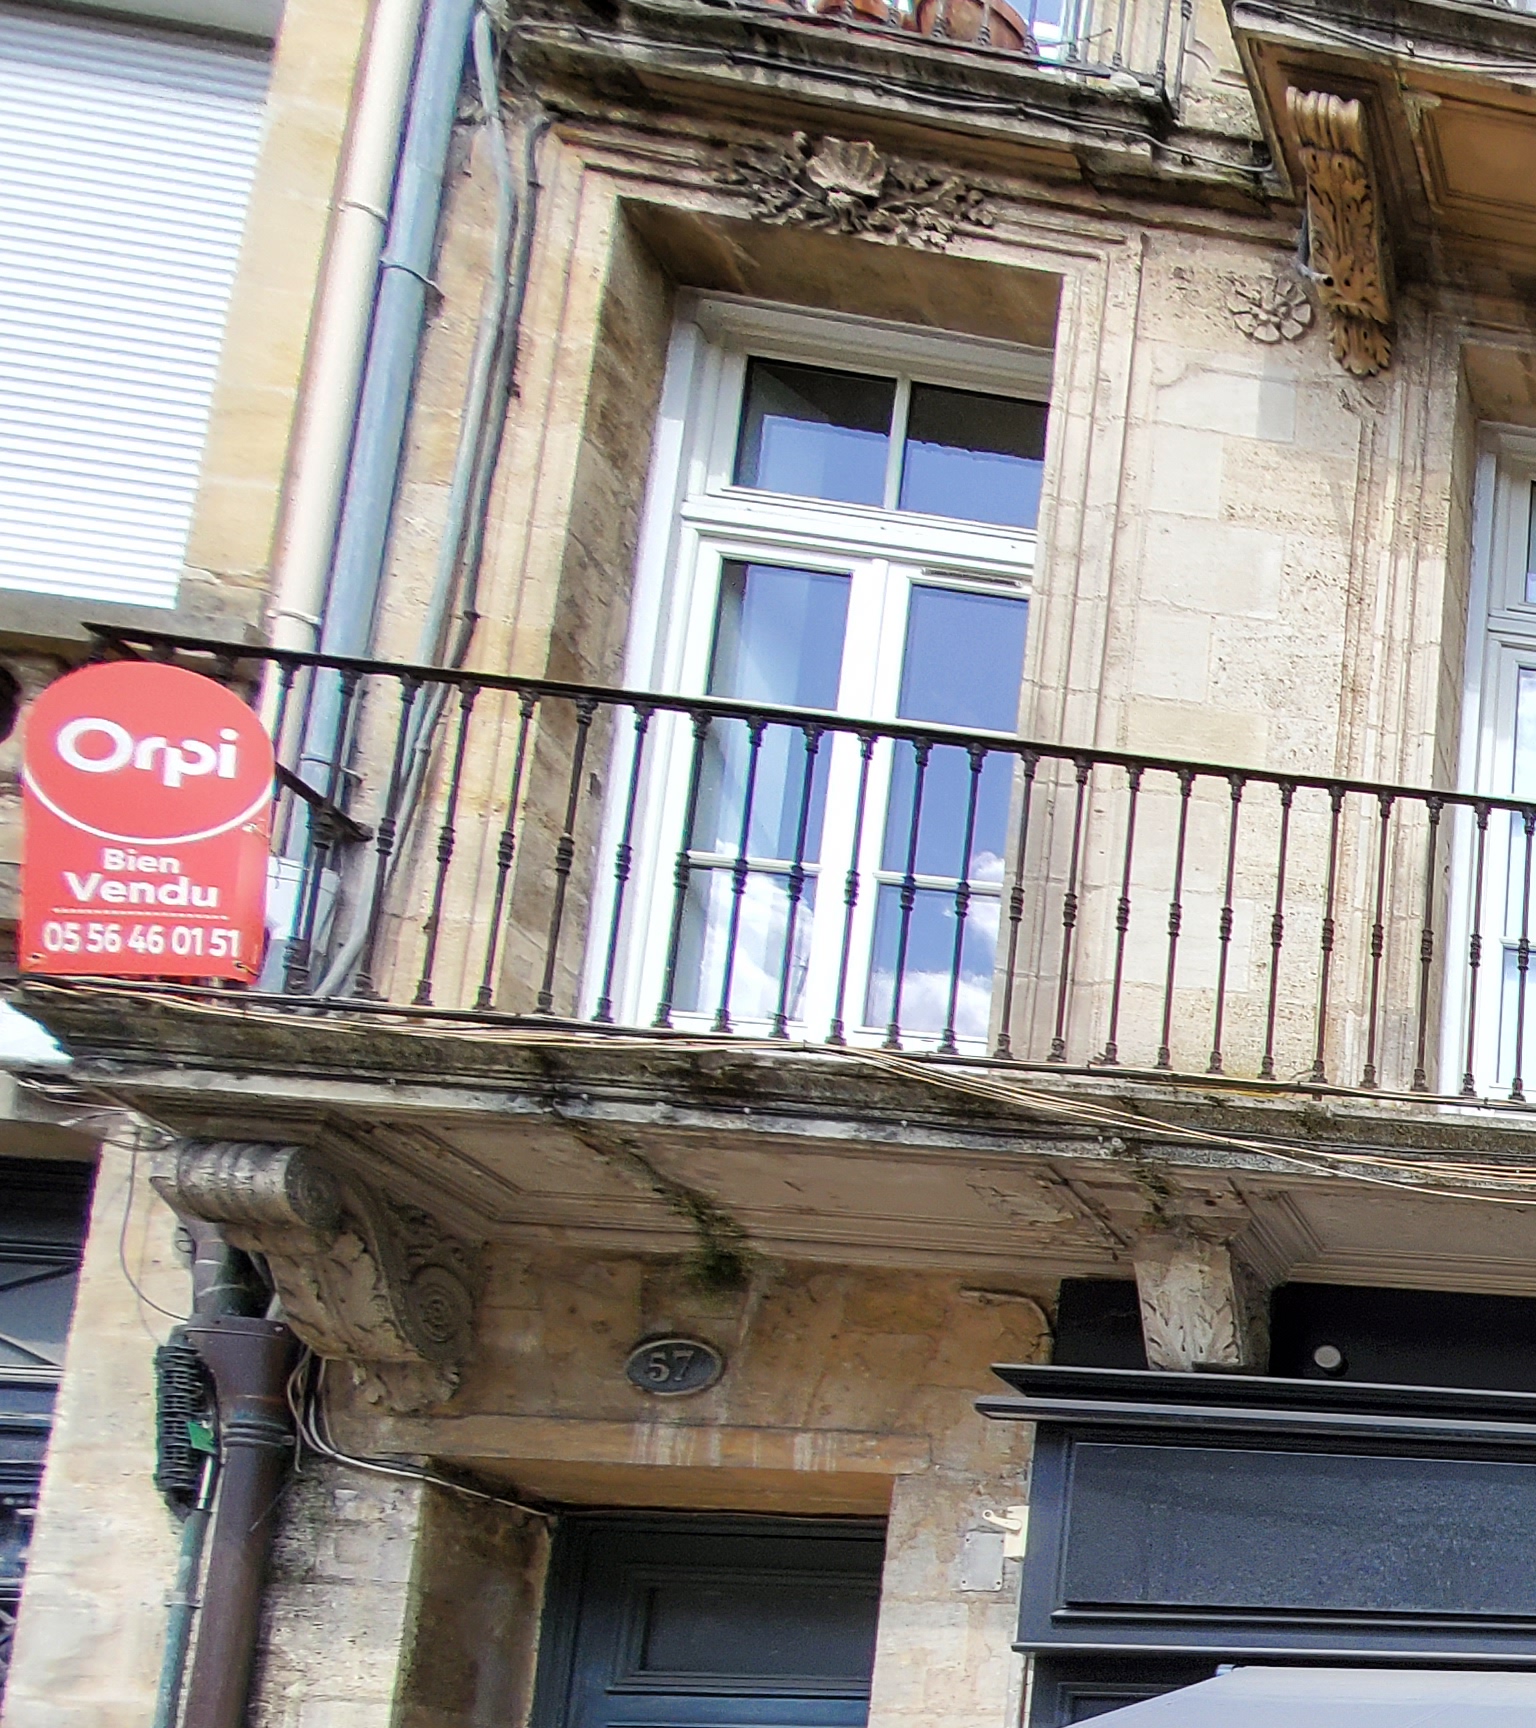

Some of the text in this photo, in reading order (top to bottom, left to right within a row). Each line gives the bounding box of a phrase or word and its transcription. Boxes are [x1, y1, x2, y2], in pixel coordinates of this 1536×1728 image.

[57, 717, 239, 788] Orpi
[102, 848, 182, 875] Bien
[62, 870, 219, 907] Vendu
[43, 922, 240, 958] 05 56 46 01 51
[647, 1350, 694, 1381] 57
